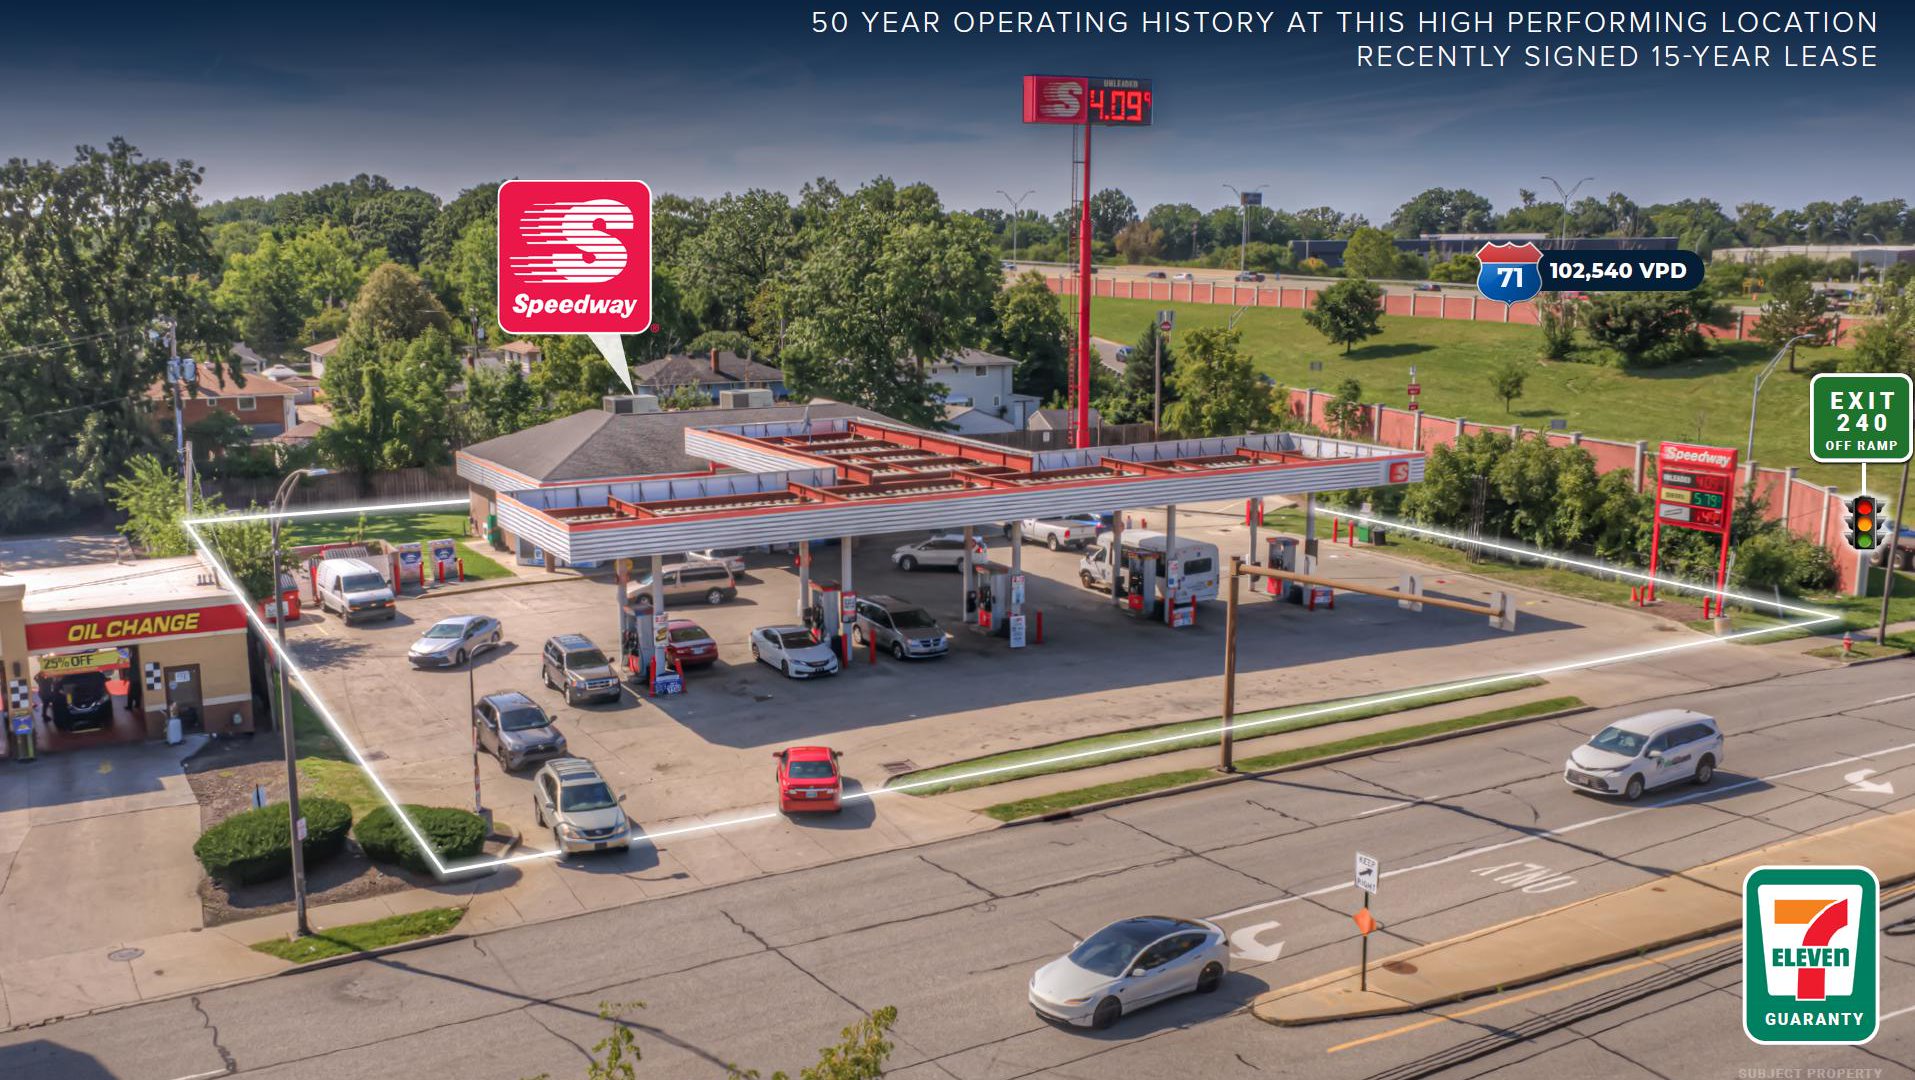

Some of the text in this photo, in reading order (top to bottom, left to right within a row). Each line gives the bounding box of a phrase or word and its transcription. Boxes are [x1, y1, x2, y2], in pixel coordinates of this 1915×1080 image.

[1663, 446, 1731, 468] Speedway
[67, 612, 200, 642] OIL CHANGE
[44, 655, 93, 669] 25% OFF
[1359, 855, 1376, 867] KEEP
[1357, 877, 1376, 892] RIGHT
